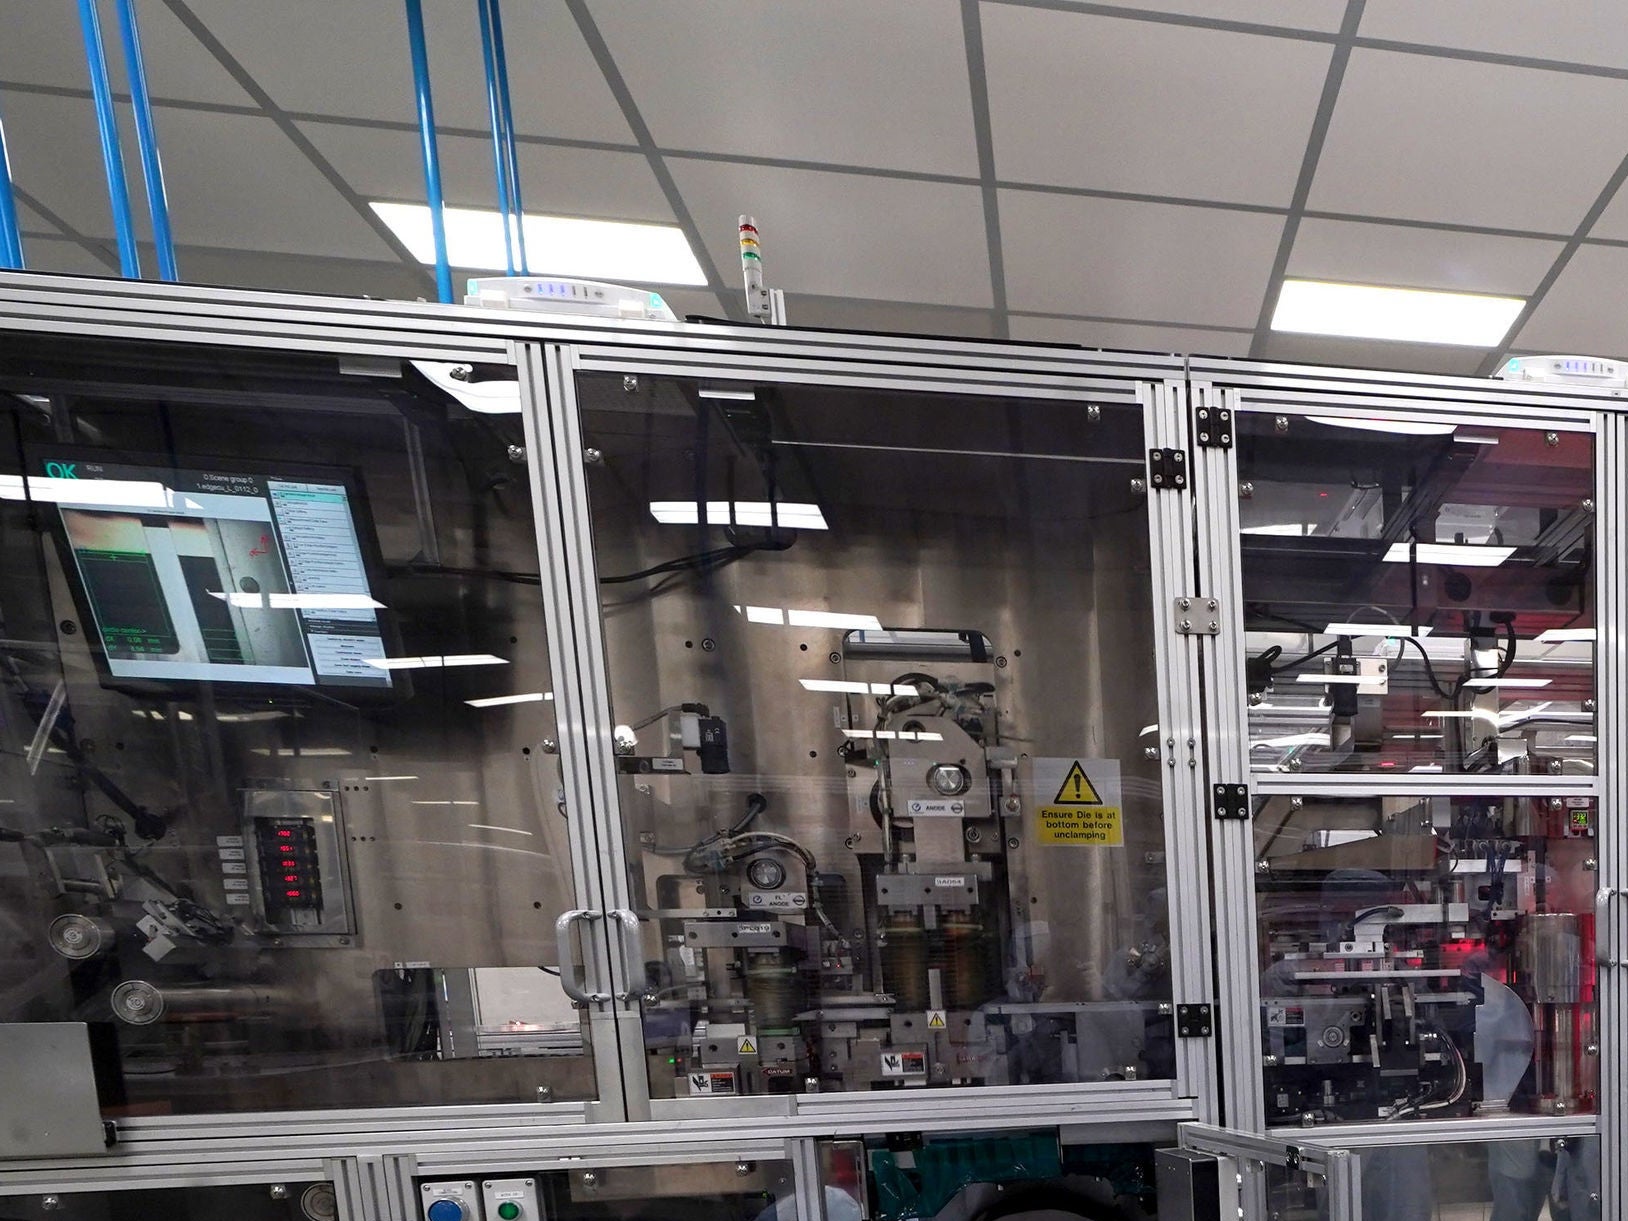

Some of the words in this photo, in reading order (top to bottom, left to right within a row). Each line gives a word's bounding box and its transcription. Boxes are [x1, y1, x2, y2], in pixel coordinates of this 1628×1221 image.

[46, 462, 79, 478] OK
[1083, 821, 1112, 829] before
[1055, 831, 1106, 840] unclamping
